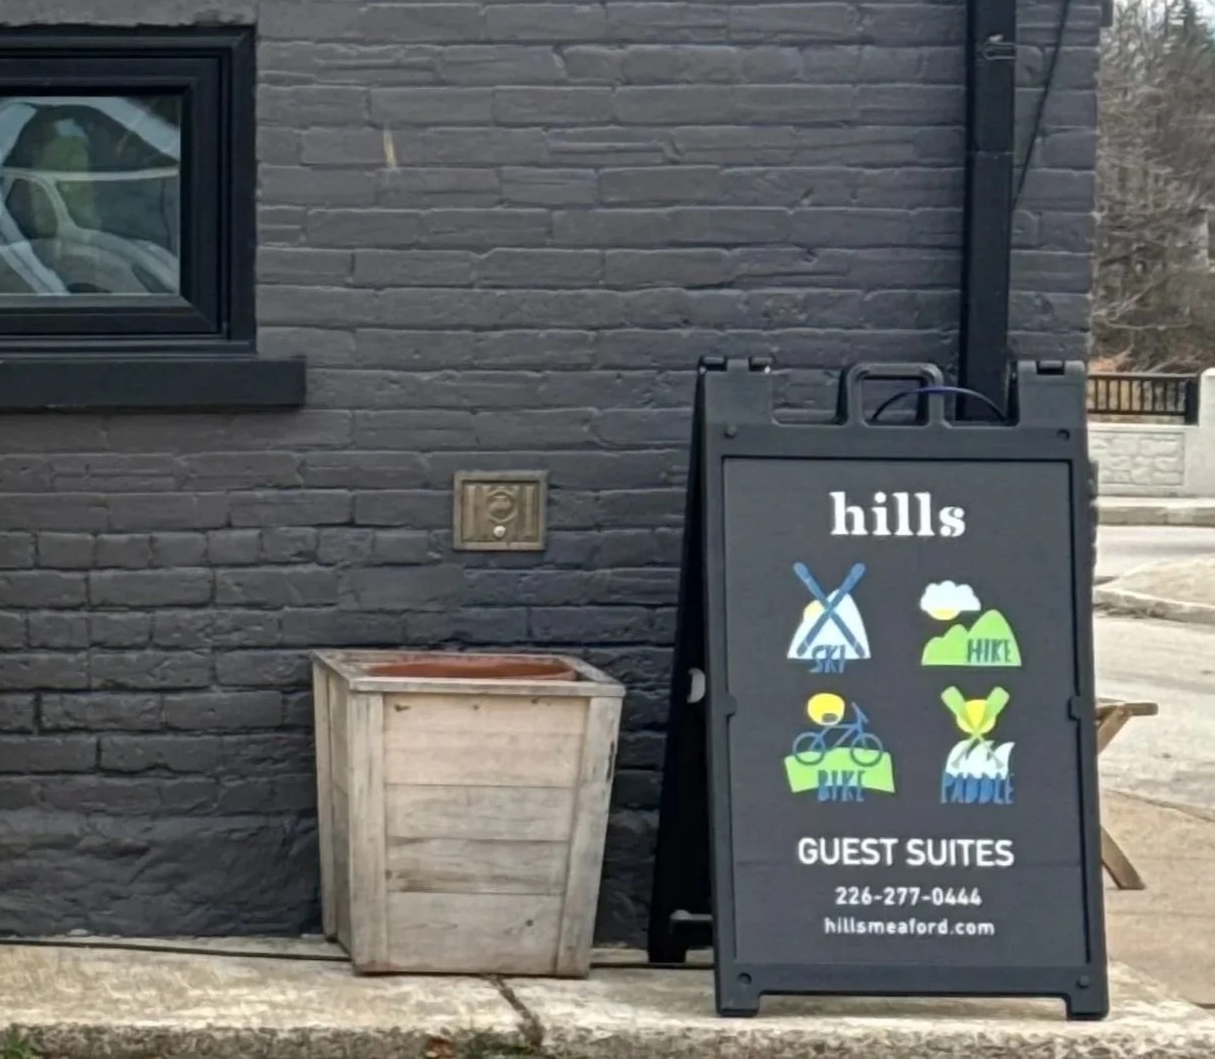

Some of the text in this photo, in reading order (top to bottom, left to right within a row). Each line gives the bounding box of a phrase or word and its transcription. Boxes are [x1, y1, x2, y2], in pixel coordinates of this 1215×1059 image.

[829, 490, 966, 538] hills
[810, 645, 846, 673] SKI
[967, 639, 1013, 663] HIKE
[817, 770, 866, 802] BIKE
[940, 772, 1015, 804] PADDLE
[797, 837, 1015, 867] GUEST SUITES
[834, 886, 983, 907] 226-277-0444
[823, 916, 996, 936] hillsmeaford.com
